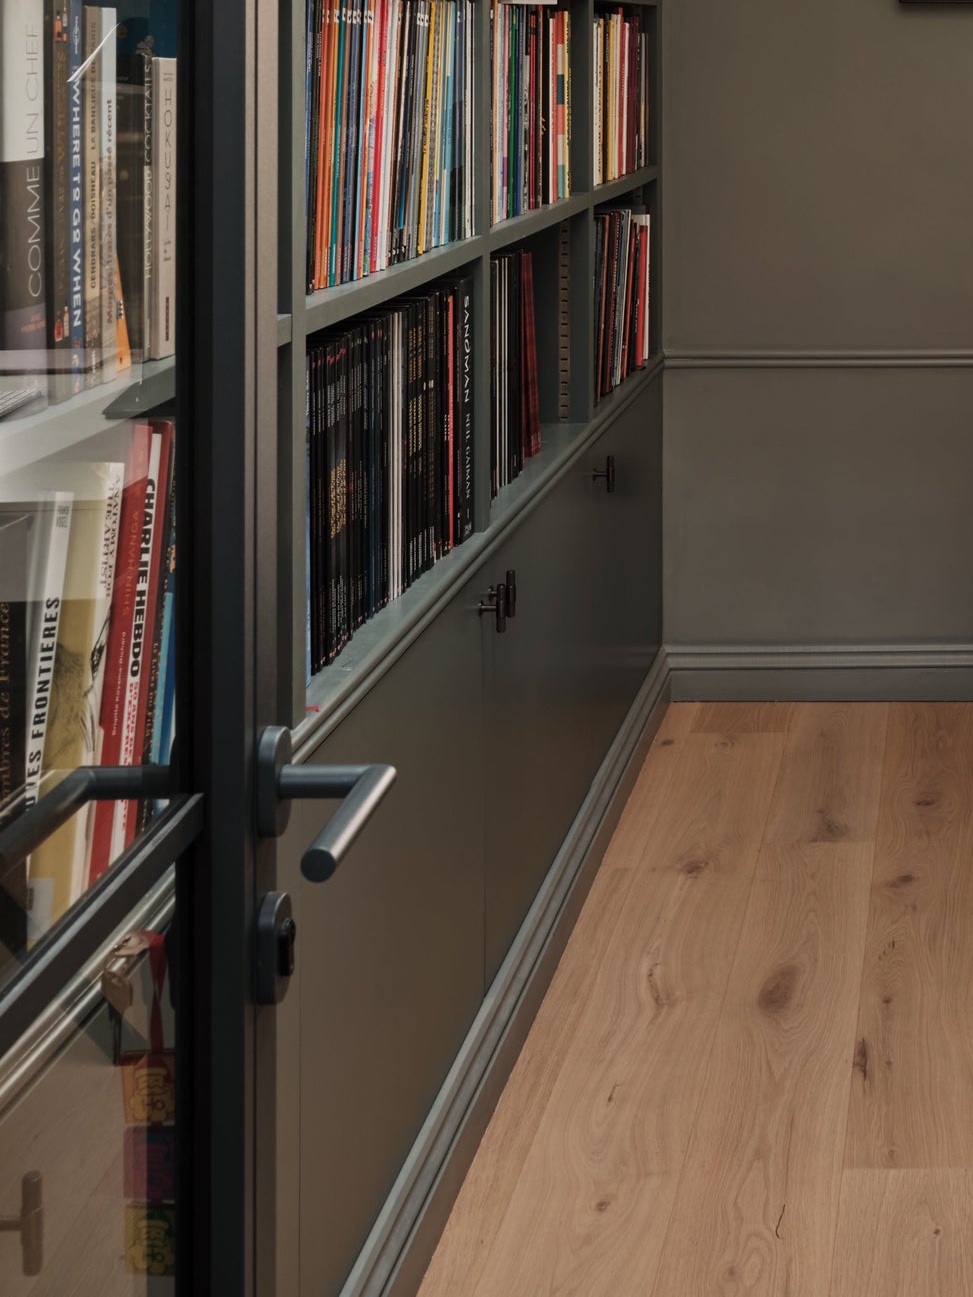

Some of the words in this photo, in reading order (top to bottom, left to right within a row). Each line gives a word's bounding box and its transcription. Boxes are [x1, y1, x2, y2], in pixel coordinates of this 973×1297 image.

[26, 23, 39, 102] CHEF
[26, 112, 39, 154] UN
[72, 81, 80, 167] WHERE
[105, 98, 113, 143] récent
[144, 64, 153, 164] COCKTAILS
[72, 173, 81, 201] TO
[164, 89, 173, 231] HOKUSAI
[26, 166, 42, 298] COMME
[72, 209, 81, 243] GO
[144, 168, 153, 279] HOLLYWOOD
[72, 248, 82, 326] WHEN
[463, 295, 471, 403] SANDMAN
[105, 483, 114, 519] THE
[109, 473, 121, 559] ANATOMY
[137, 478, 155, 583] CHARLIE
[99, 522, 110, 587] ARTIST
[105, 562, 113, 599] FOR
[122, 573, 132, 616] SHIN
[127, 510, 139, 570] HANGA
[31, 596, 60, 741] FRONTIERES
[129, 589, 146, 678] HEBDO
